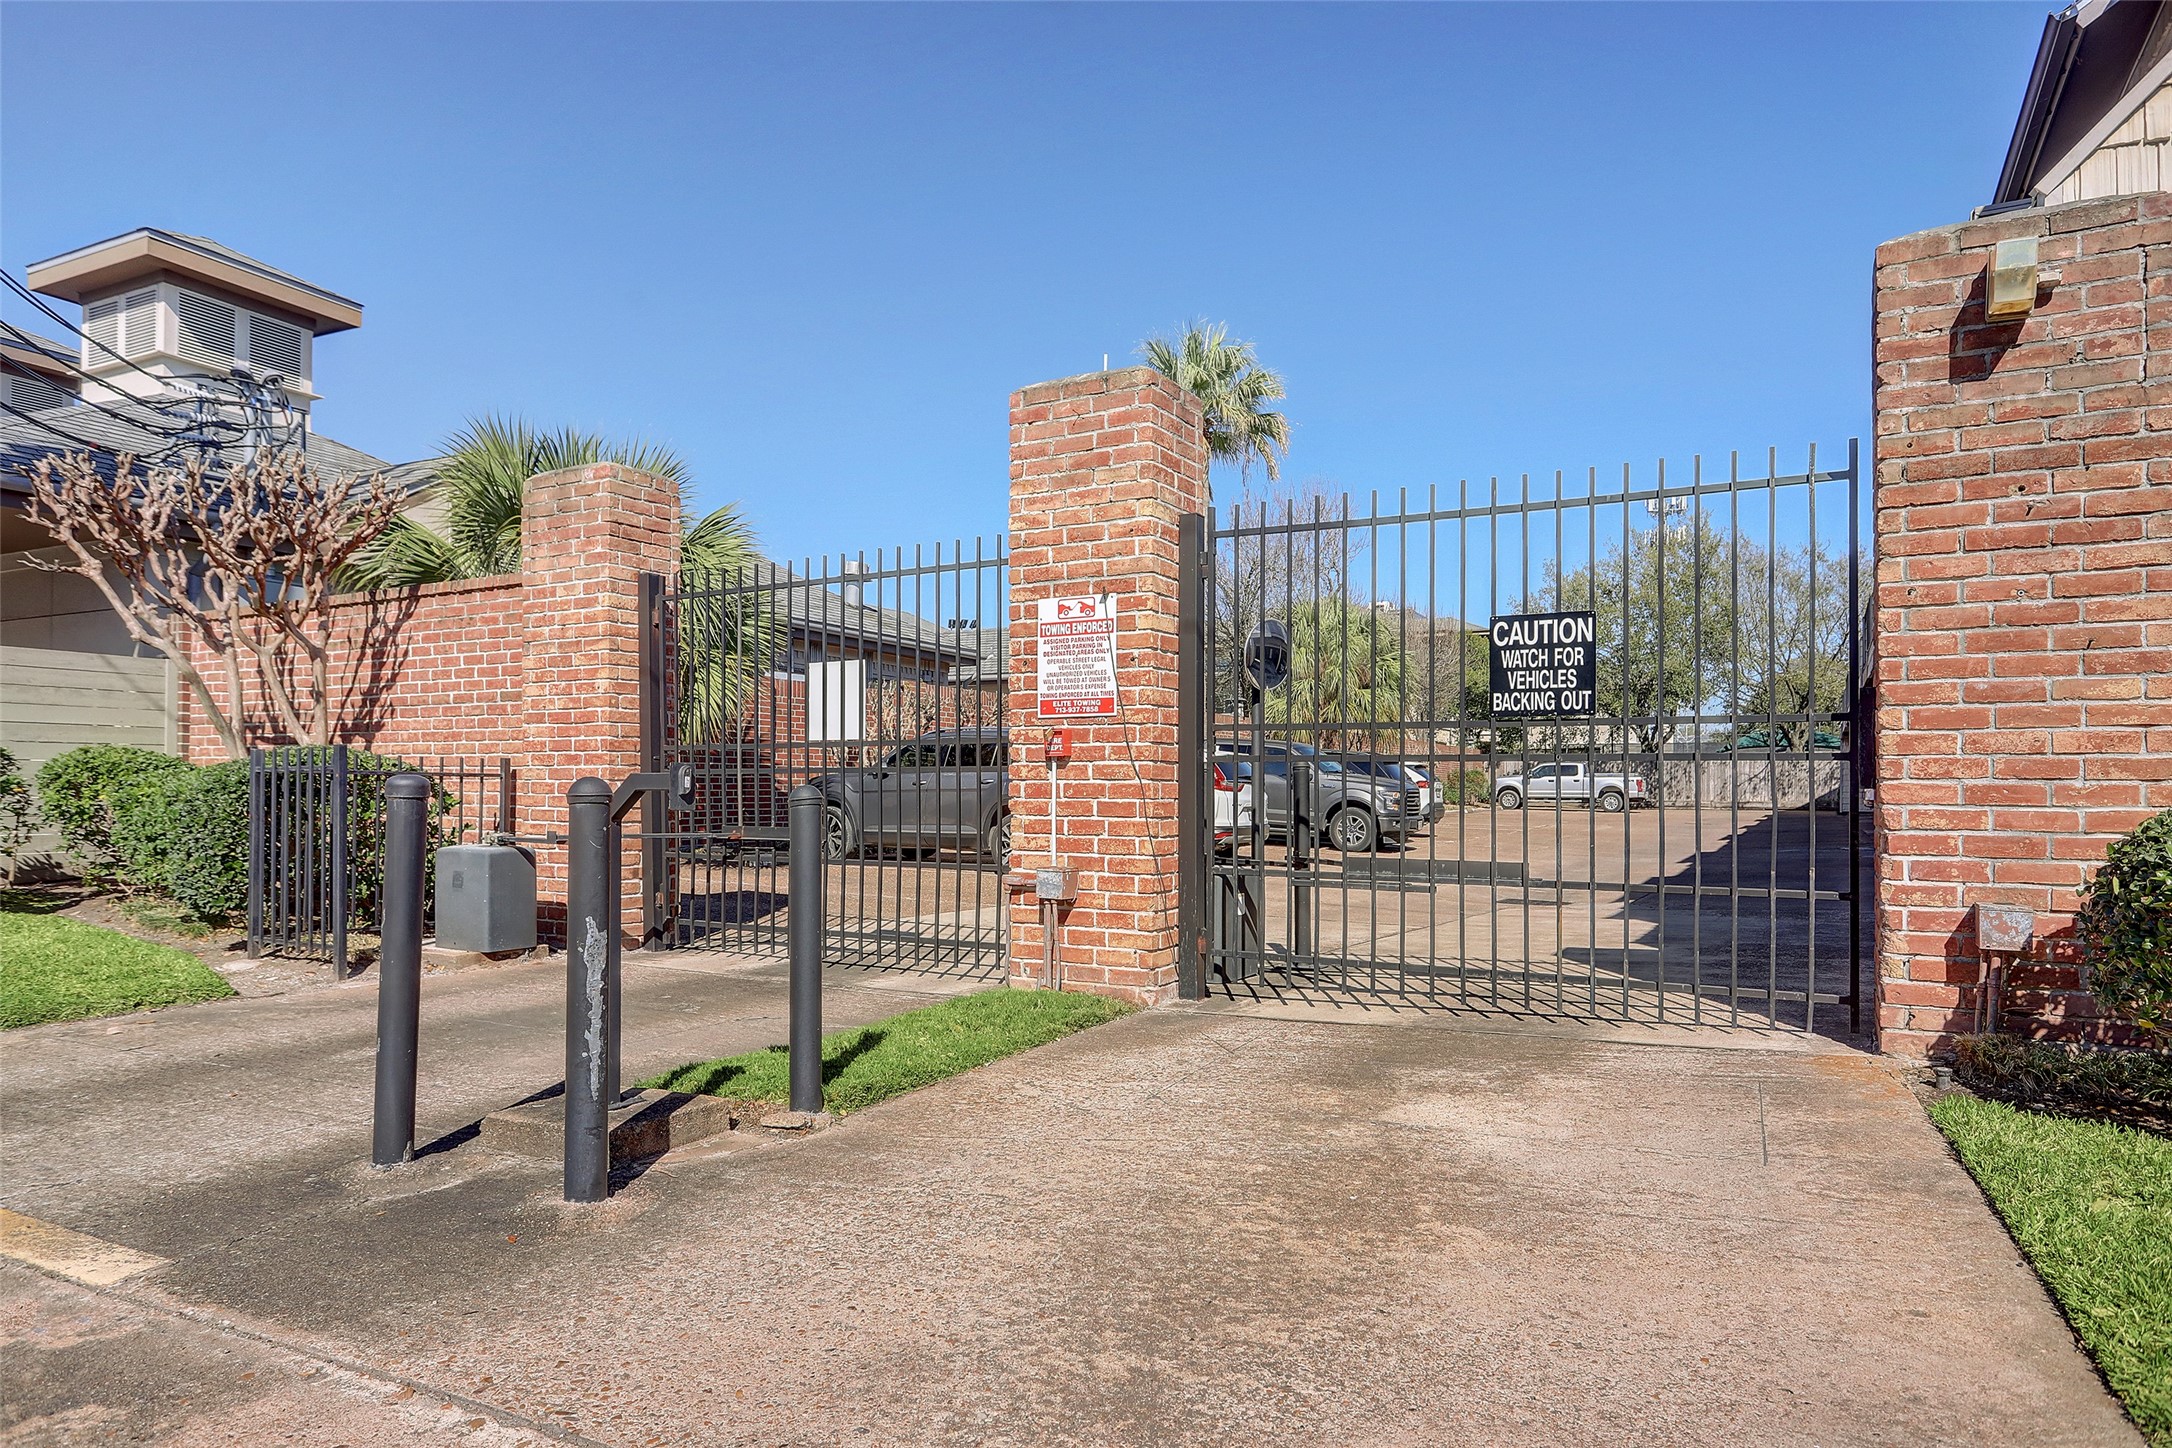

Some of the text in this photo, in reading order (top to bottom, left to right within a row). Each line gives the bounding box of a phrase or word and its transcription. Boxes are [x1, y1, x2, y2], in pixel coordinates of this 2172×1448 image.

[1041, 620, 1113, 636] TOWING ENFORCED
[1493, 617, 1593, 647] CAUTION
[1043, 637, 1069, 645] ASSIGNED
[1047, 657, 1071, 665] OPERABLE
[1501, 647, 1584, 668] WATCH FOR
[1507, 669, 1577, 689] VEHICLES
[1493, 690, 1592, 711] BACKING OUT
